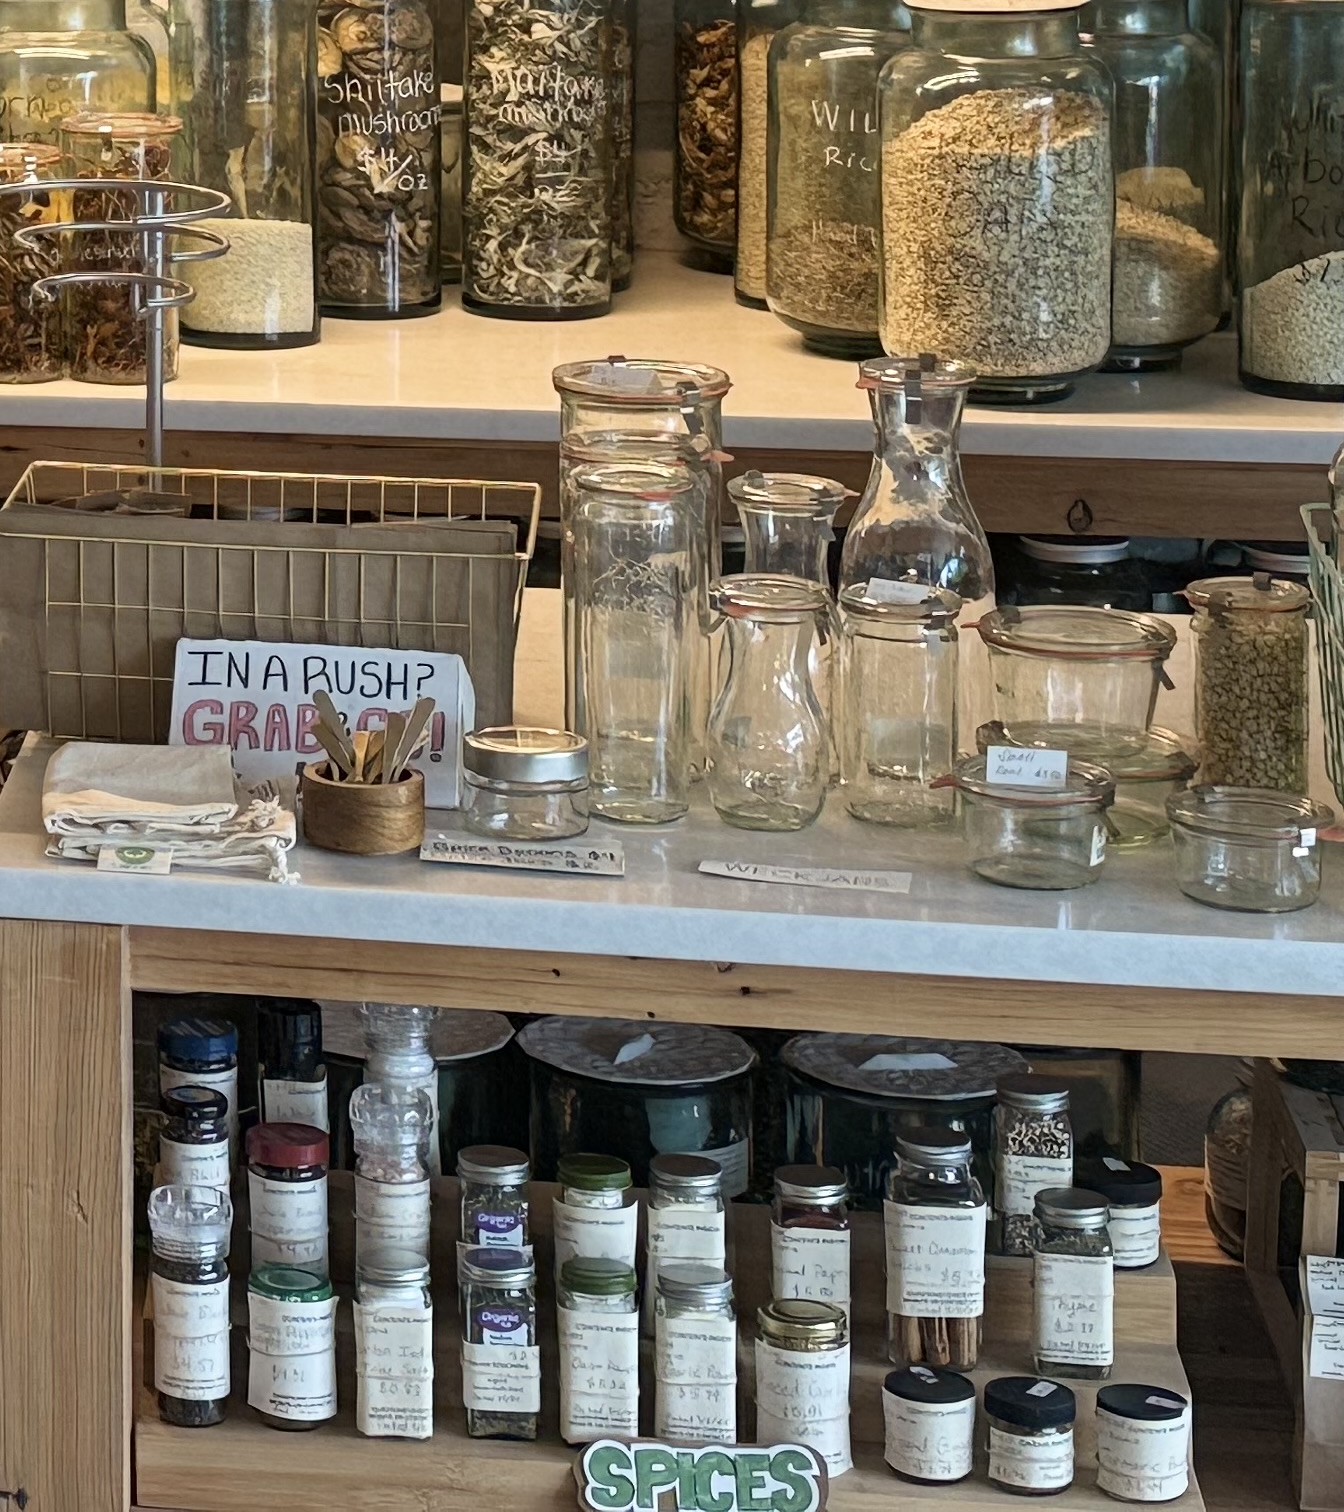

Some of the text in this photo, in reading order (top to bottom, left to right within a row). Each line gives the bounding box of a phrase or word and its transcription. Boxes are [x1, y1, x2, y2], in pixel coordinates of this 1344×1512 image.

[811, 99, 878, 135] WIL
[823, 145, 879, 173] Ric
[1291, 194, 1344, 240] Ric
[187, 650, 435, 701] IN A RUSH?
[182, 699, 322, 753] GRAB
[588, 1443, 814, 1512] SPICES
